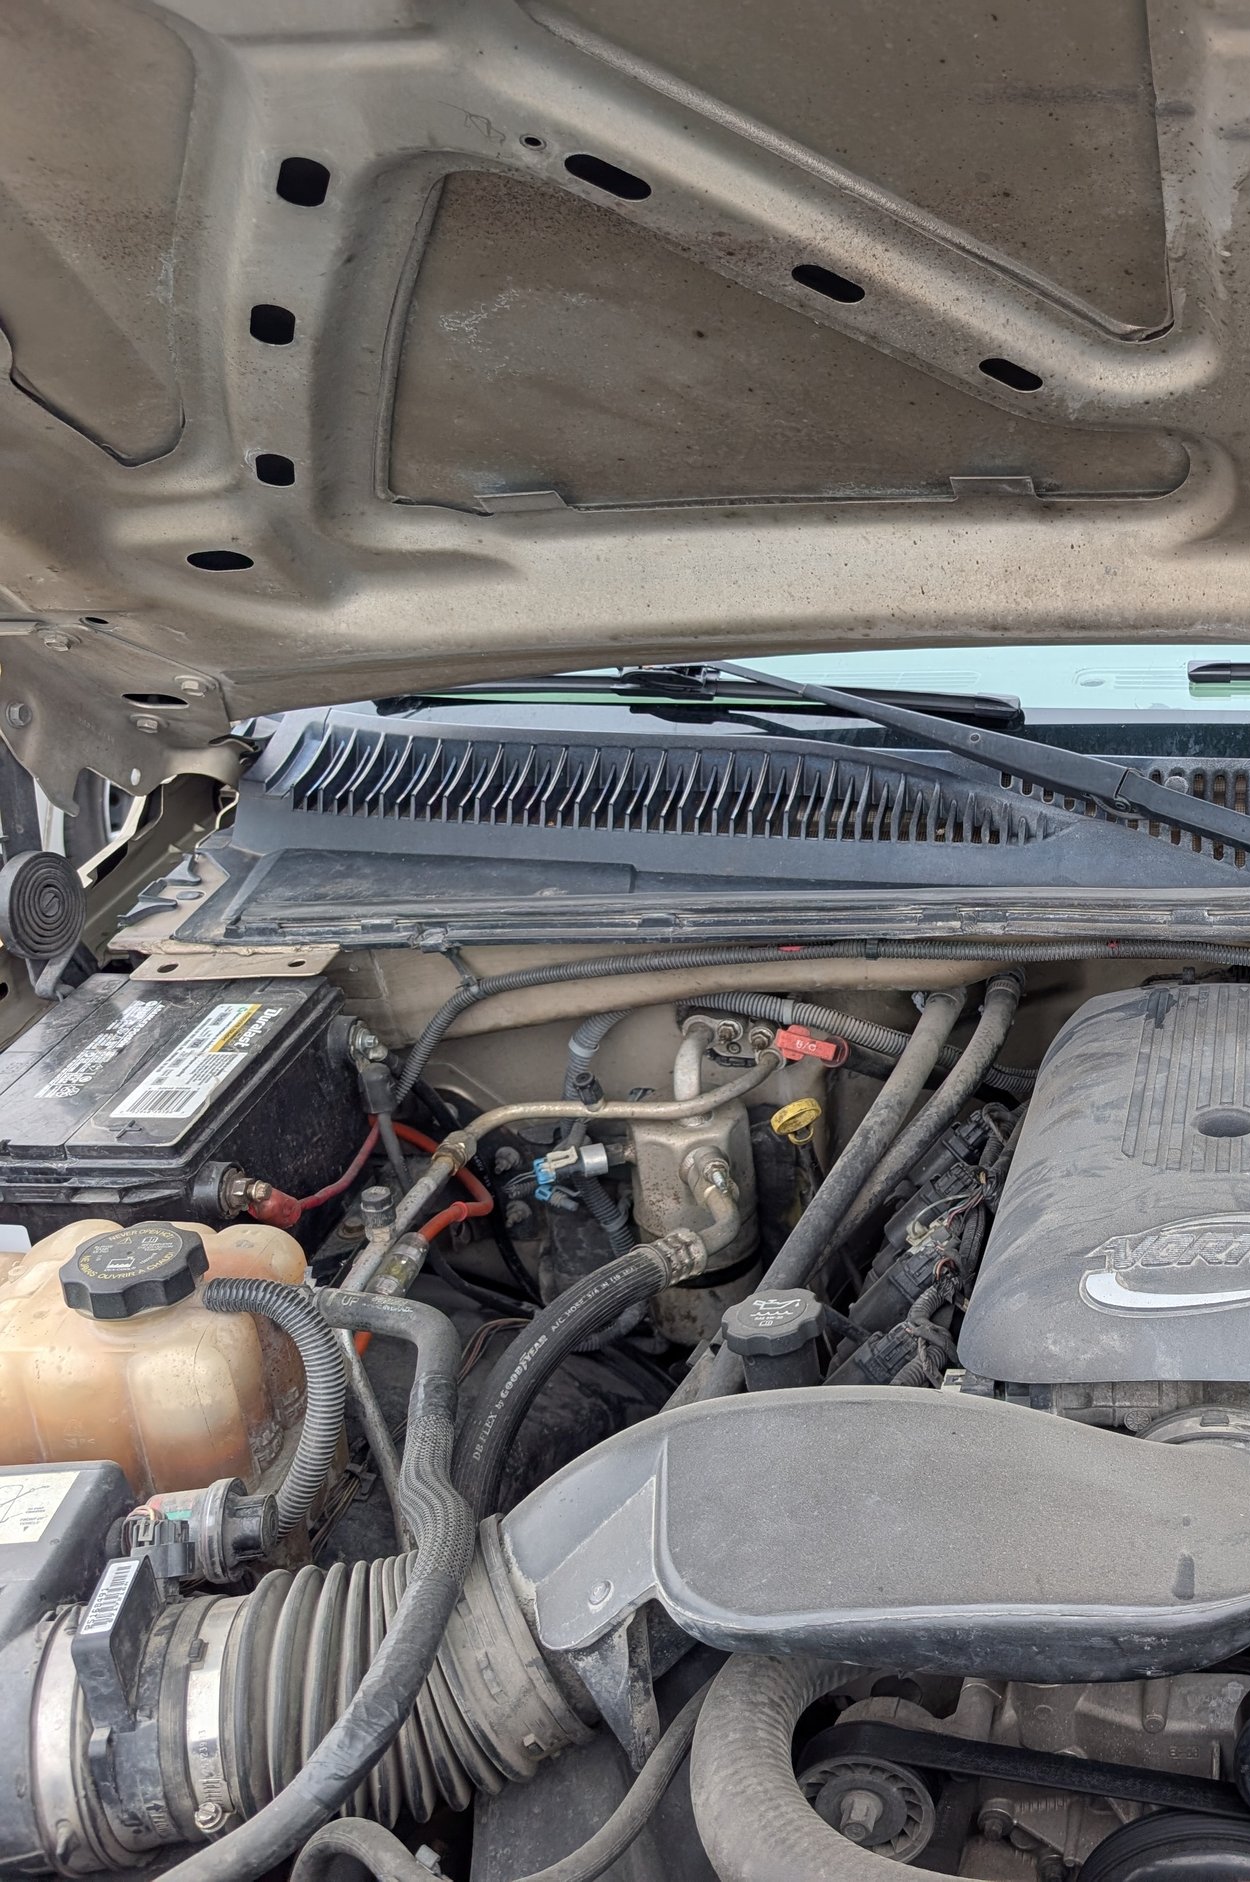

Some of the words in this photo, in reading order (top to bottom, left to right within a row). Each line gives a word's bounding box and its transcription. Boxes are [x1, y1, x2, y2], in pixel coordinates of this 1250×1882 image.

[234, 1008, 283, 1047] Duralast
[108, 1230, 139, 1241] NEVER
[98, 1271, 136, 1279] OUVRIR
[341, 1295, 360, 1306] UP
[472, 1441, 485, 1461] DB
[480, 1412, 498, 1442] FLEX
[495, 1399, 505, 1410] by
[500, 1334, 549, 1399] GOODYEAR
[551, 1316, 566, 1332] A/C
